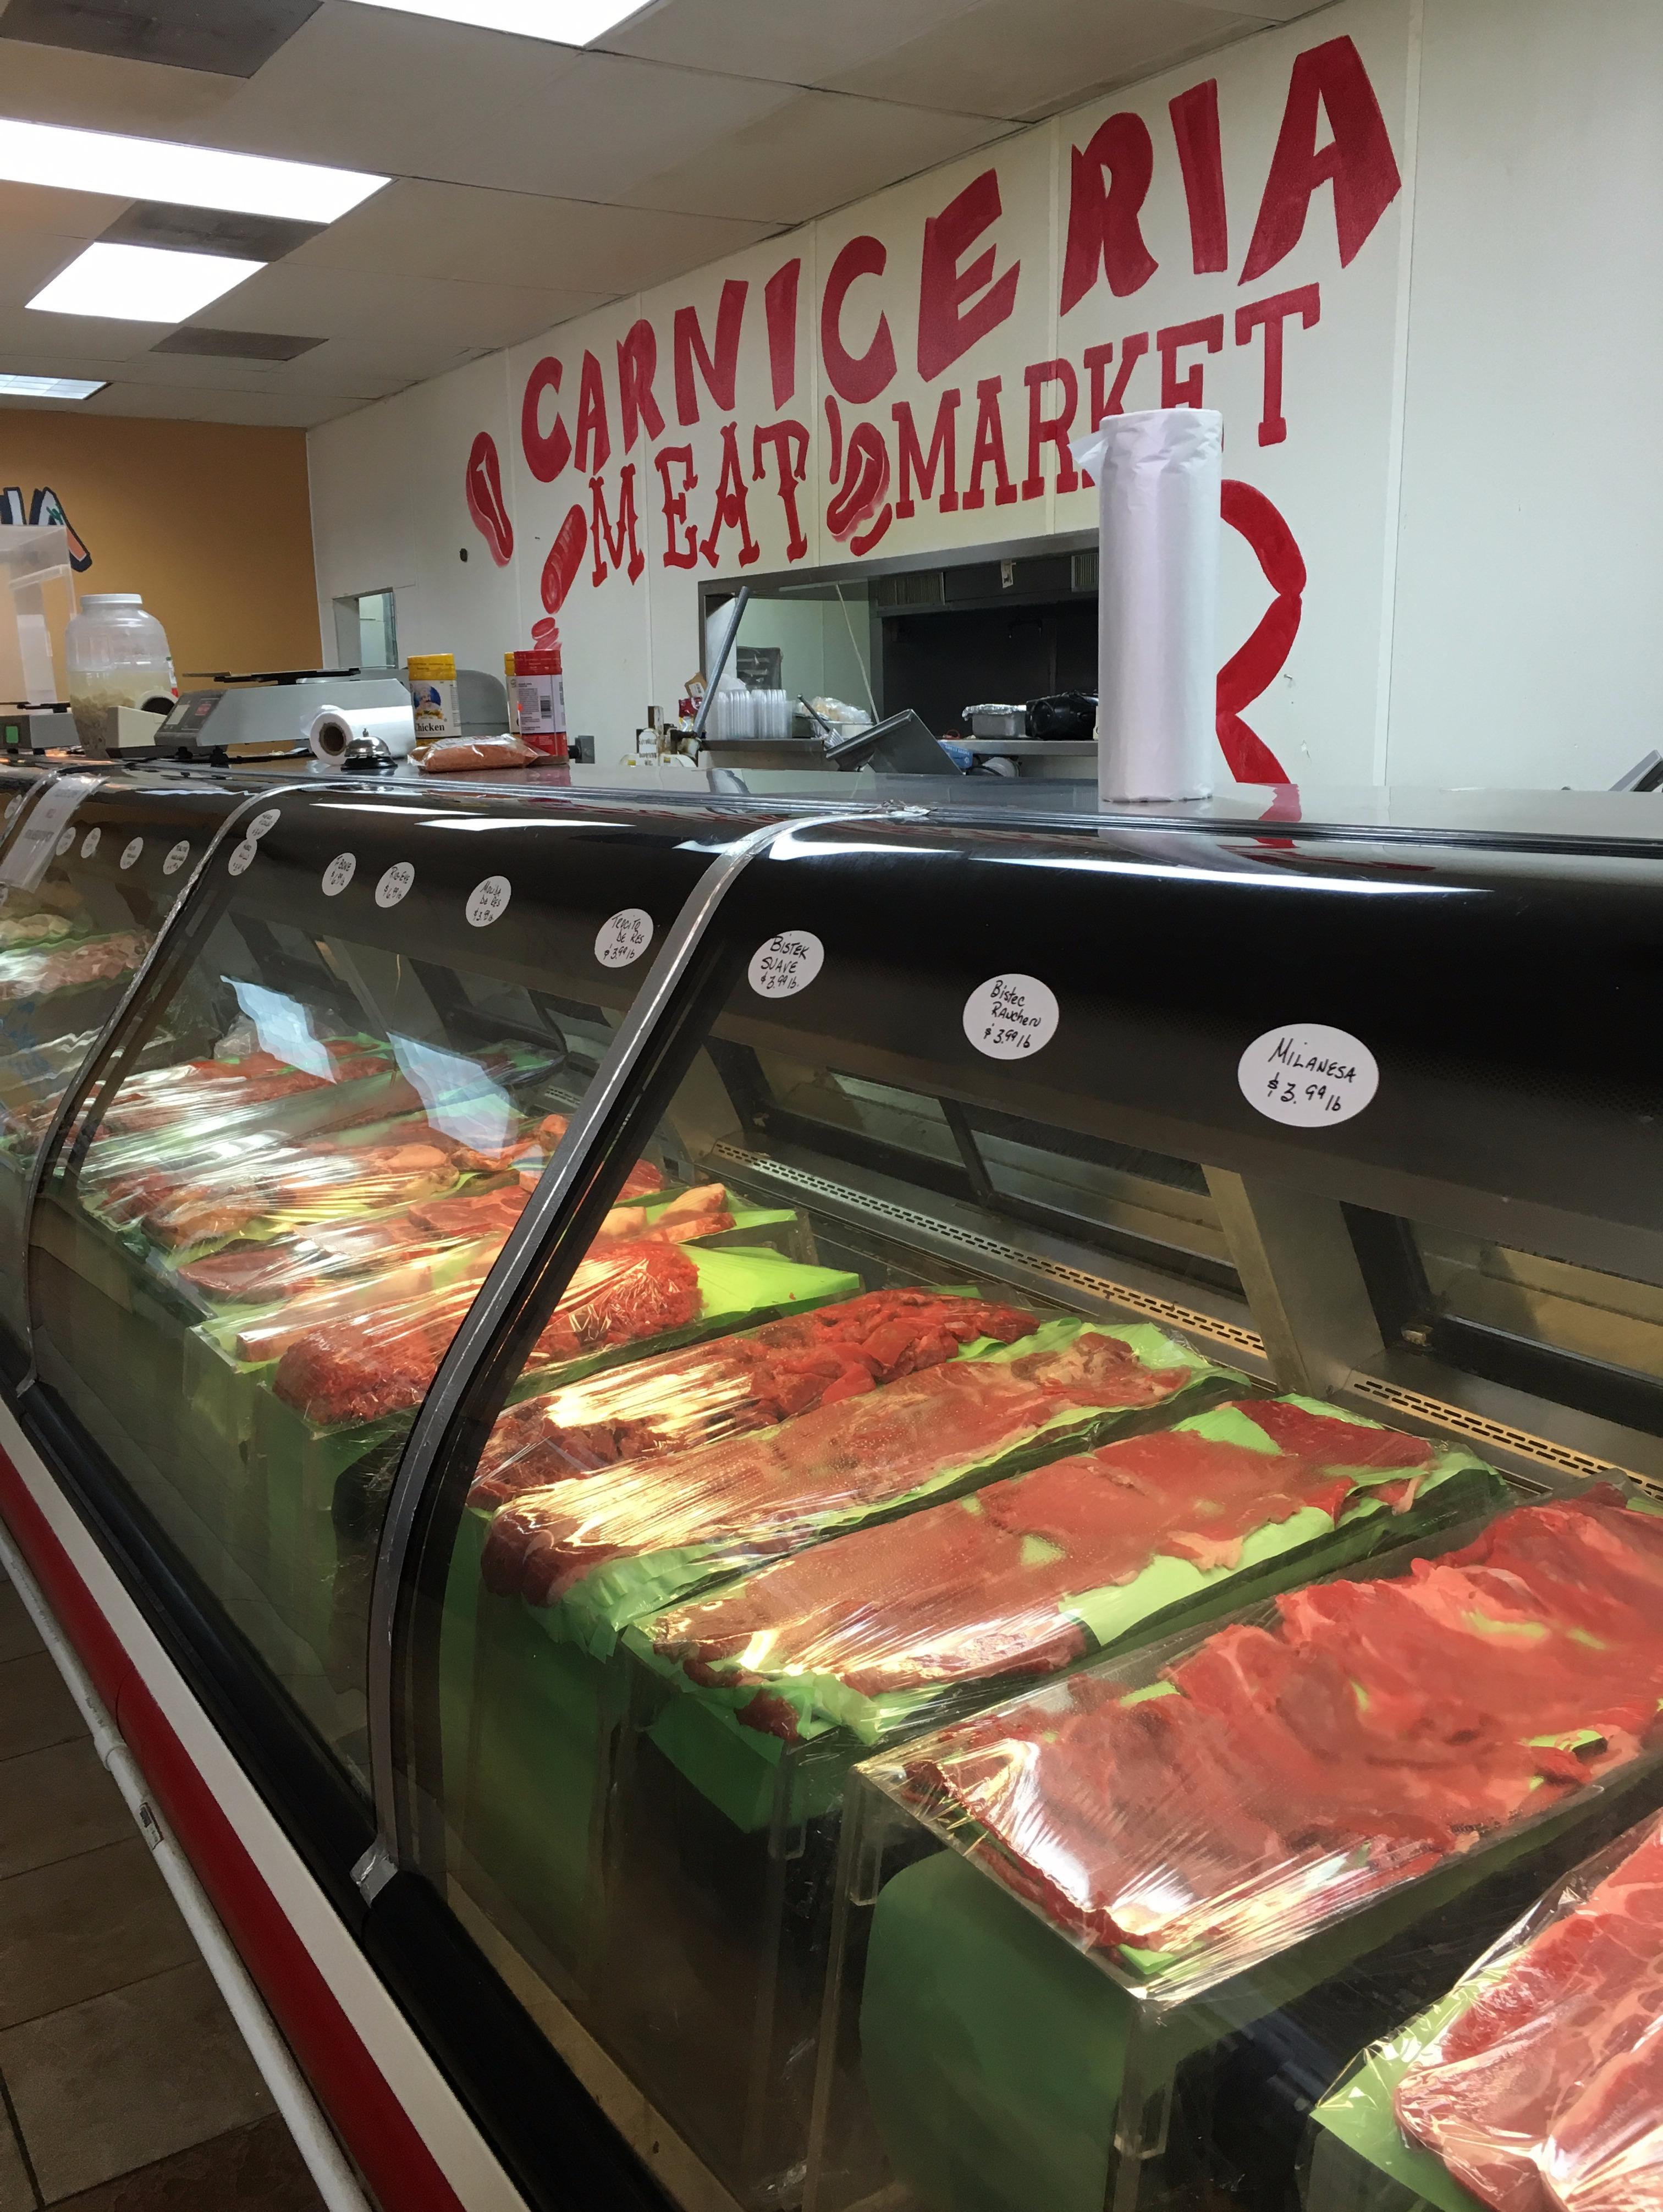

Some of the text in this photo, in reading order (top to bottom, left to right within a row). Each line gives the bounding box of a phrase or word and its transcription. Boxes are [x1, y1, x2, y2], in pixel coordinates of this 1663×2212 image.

[521, 35, 1402, 482] CARNICERIA
[590, 282, 1320, 587] MEAT MARKET
[616, 928, 645, 944] DE RES
[770, 934, 810, 960] BISTEK
[761, 956, 798, 973] SUAVE
[990, 980, 1025, 1007] Bistec
[1268, 1037, 1357, 1083] MILANESA
